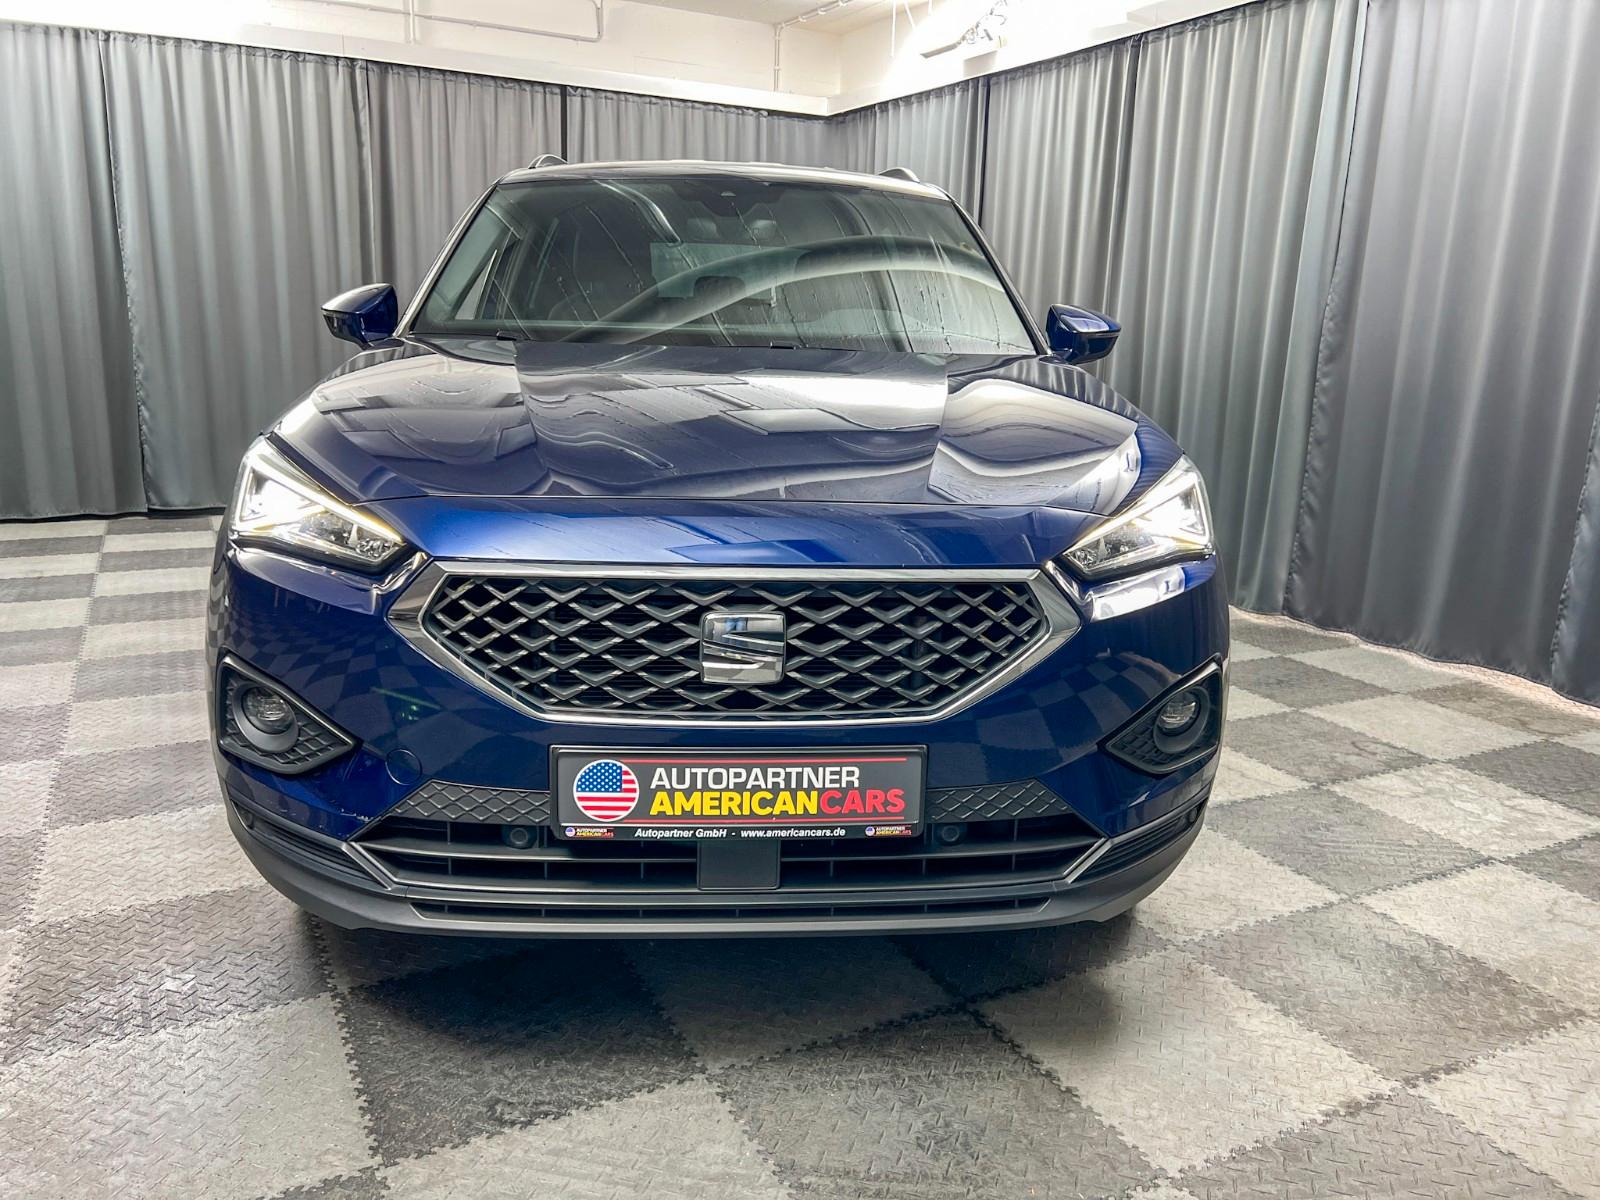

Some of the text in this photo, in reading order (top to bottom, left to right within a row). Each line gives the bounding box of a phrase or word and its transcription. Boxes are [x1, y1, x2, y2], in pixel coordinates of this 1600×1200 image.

[650, 766, 860, 790] AUTOPARTNER
[649, 788, 906, 816] AMERICANCARS
[634, 828, 694, 839] Autopartner
[695, 828, 727, 838] GmbH
[740, 827, 846, 838] www.americancars.de
